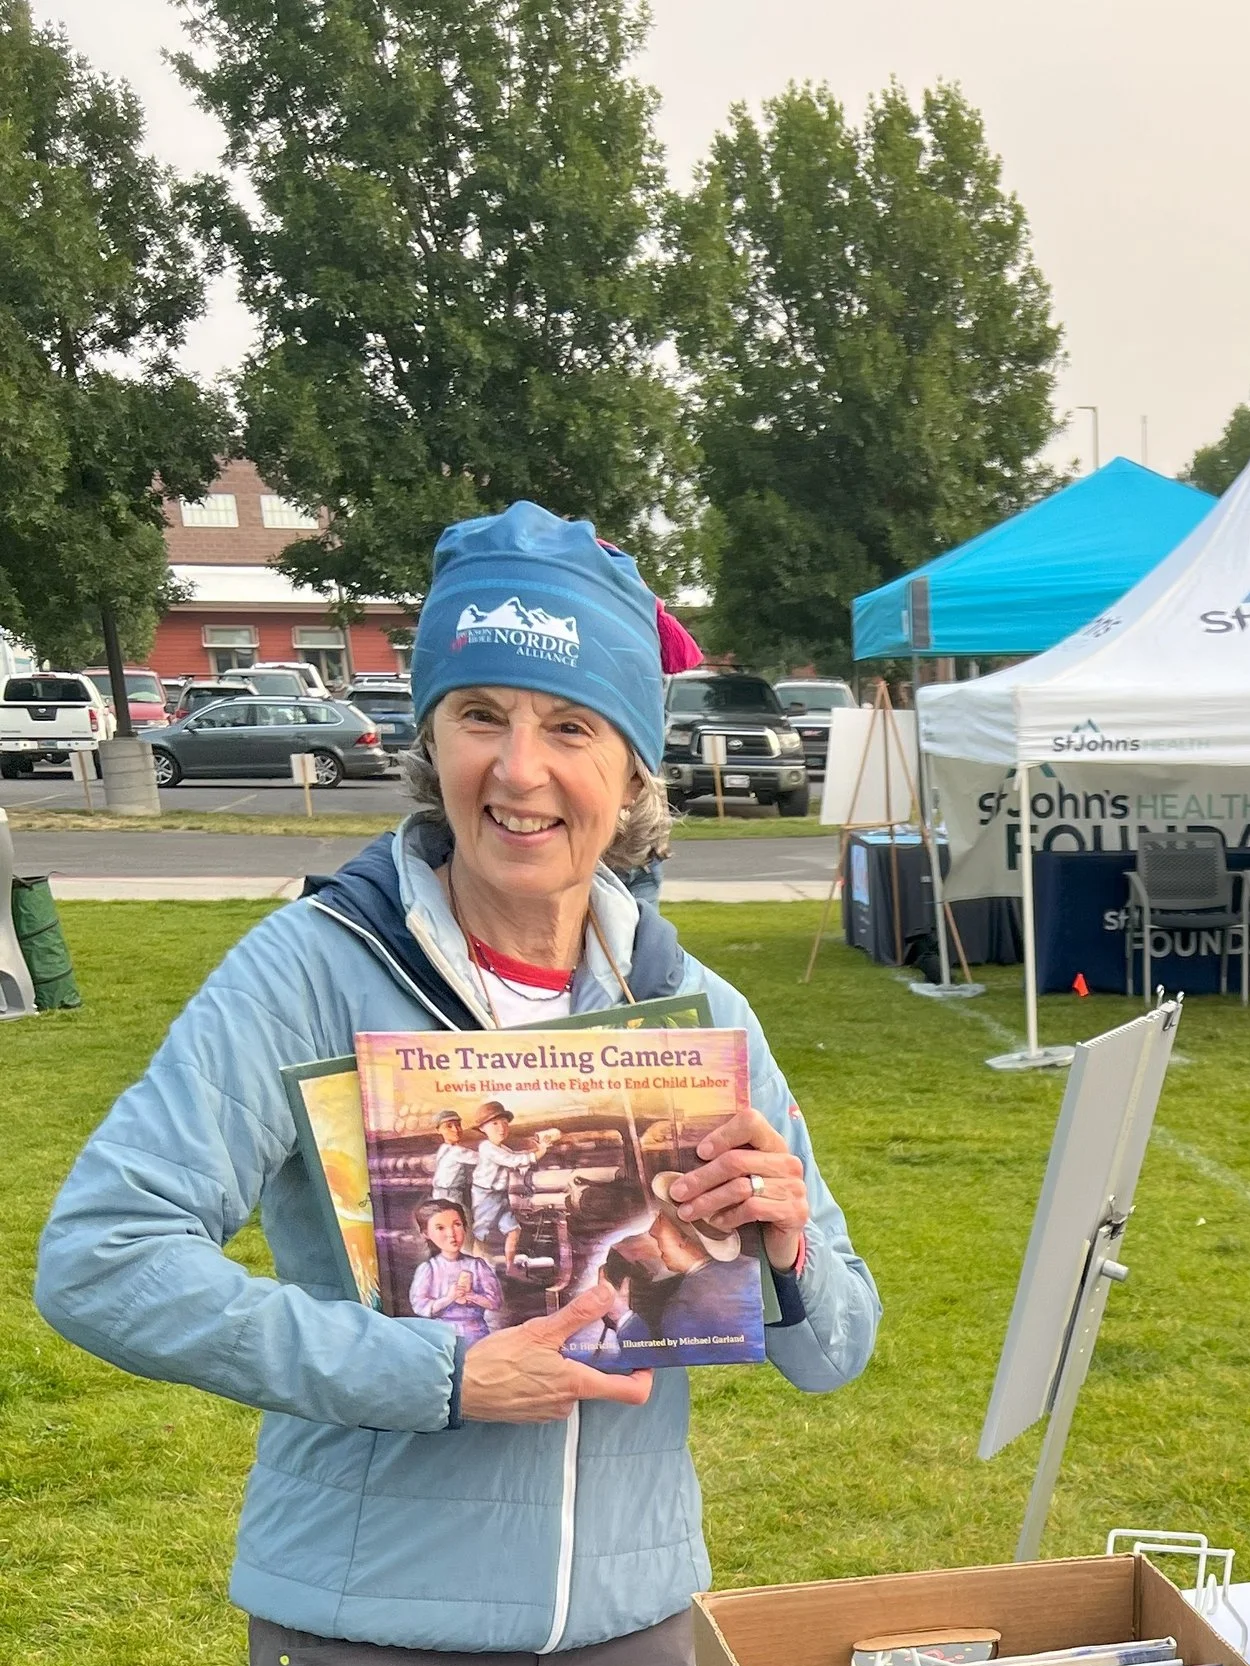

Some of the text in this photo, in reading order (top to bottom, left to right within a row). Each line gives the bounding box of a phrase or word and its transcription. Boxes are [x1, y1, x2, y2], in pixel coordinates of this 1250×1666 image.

[494, 628, 580, 659] NORDIC
[516, 647, 577, 668] ALLIANCE
[1143, 738, 1210, 750] HEALTH
[395, 1045, 703, 1074] The Traveling Camera
[436, 1076, 730, 1093] Lewis Hine and the Fight to End Child Labor
[622, 1337, 667, 1348] Illustrated
[667, 1338, 677, 1348] by
[679, 1336, 711, 1346] Michael
[712, 1334, 745, 1344] Garland
